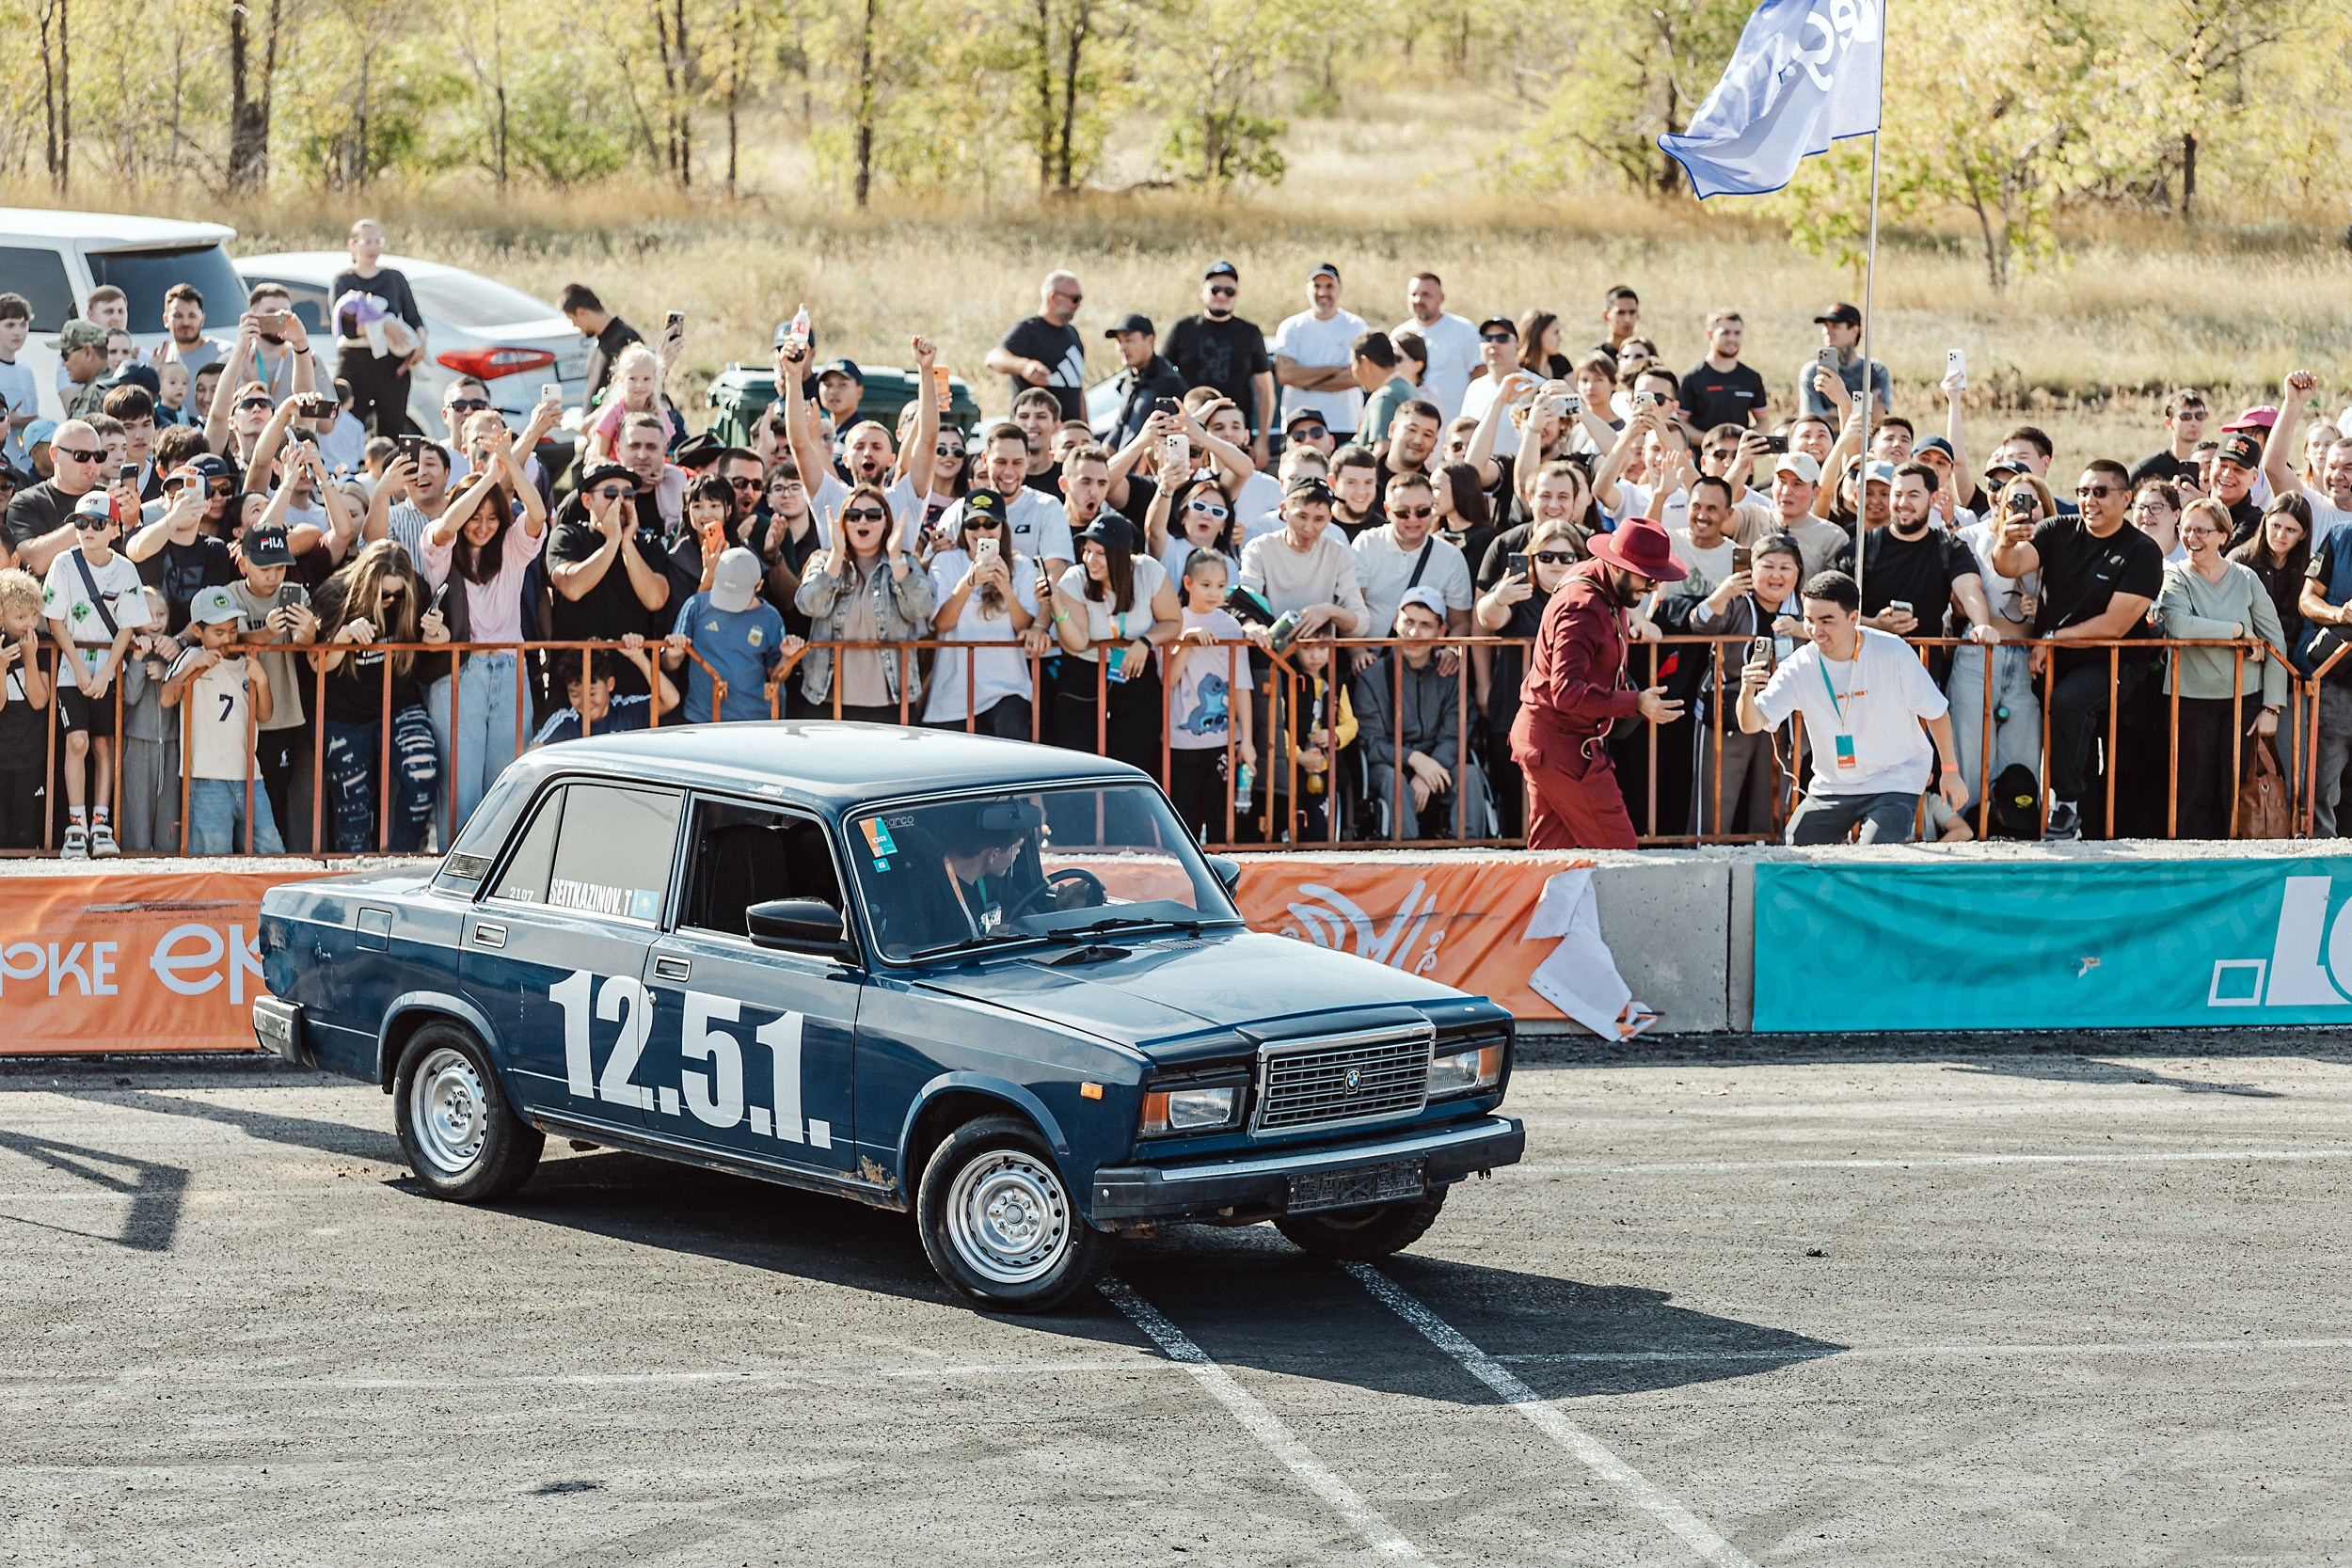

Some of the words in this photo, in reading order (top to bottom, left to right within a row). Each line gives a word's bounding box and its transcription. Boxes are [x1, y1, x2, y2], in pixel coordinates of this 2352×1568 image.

[260, 536, 284, 551] FILA
[218, 693, 234, 722] 7
[509, 886, 534, 903] 2107
[548, 969, 832, 1150] 12.5.1.
